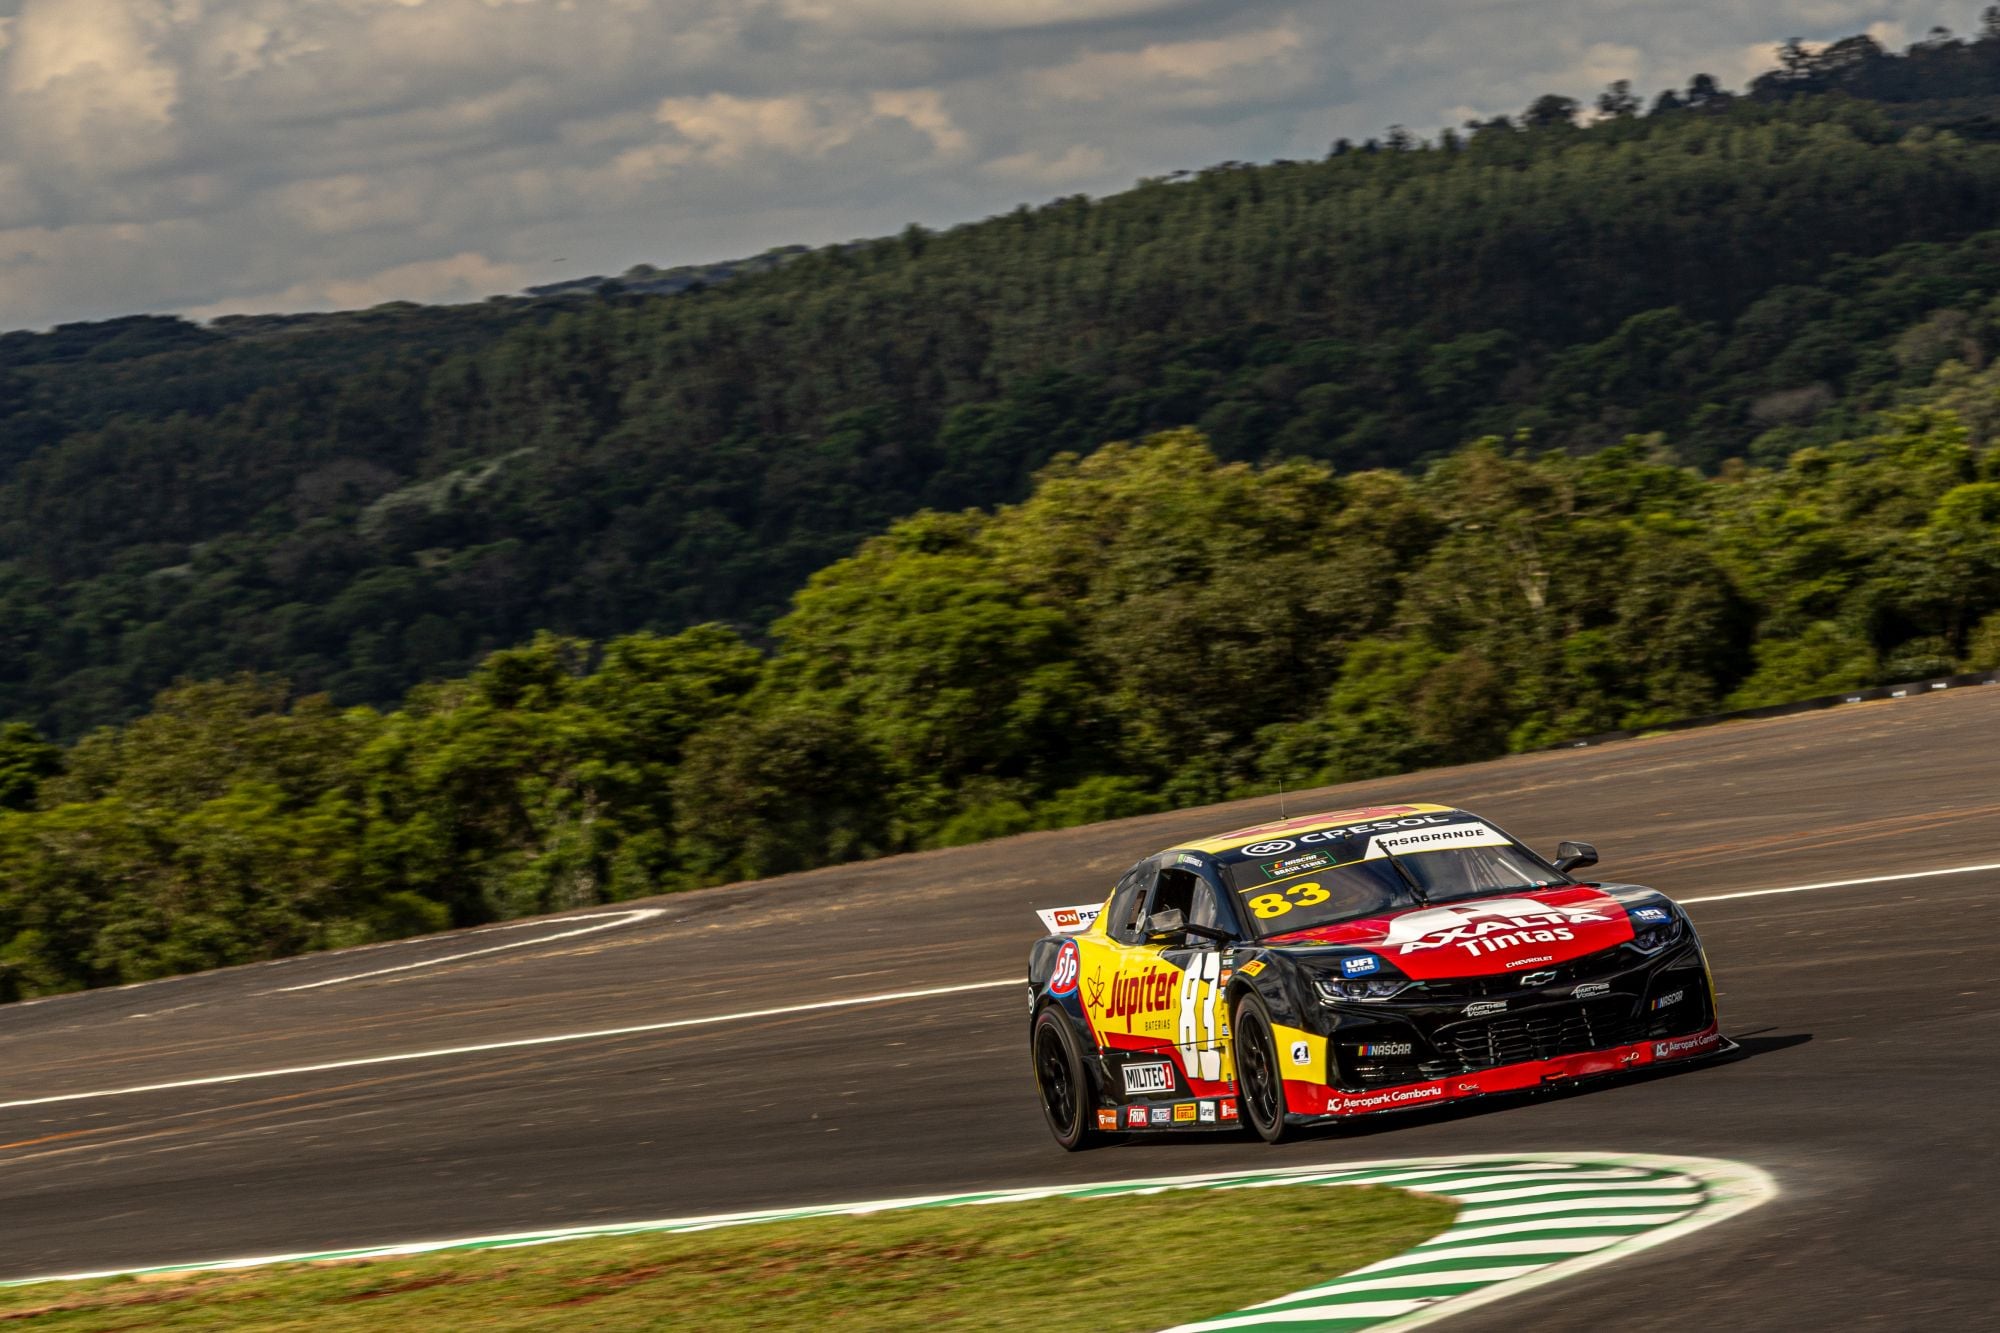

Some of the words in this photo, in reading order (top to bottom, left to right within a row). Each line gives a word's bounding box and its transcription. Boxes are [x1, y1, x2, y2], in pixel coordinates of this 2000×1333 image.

[1299, 815, 1450, 843] CRESOL
[1274, 865, 1301, 876] BRASIL
[1301, 860, 1327, 871] SERIES
[1284, 854, 1317, 867] NASCAR
[1247, 882, 1331, 919] 83
[1057, 913, 1078, 923] ON
[1399, 908, 1613, 955] AXALTA
[1456, 925, 1575, 957] Tintas
[1053, 947, 1078, 988] STP
[1345, 957, 1374, 969] UFI
[1346, 964, 1376, 974] FILTERS
[1505, 955, 1553, 968] CHEVROLET
[1179, 952, 1220, 1081] 83
[1145, 1020, 1170, 1031] BATERIAS
[1371, 1043, 1412, 1056] NASCAR
[1343, 1093, 1391, 1108] Aeropark
